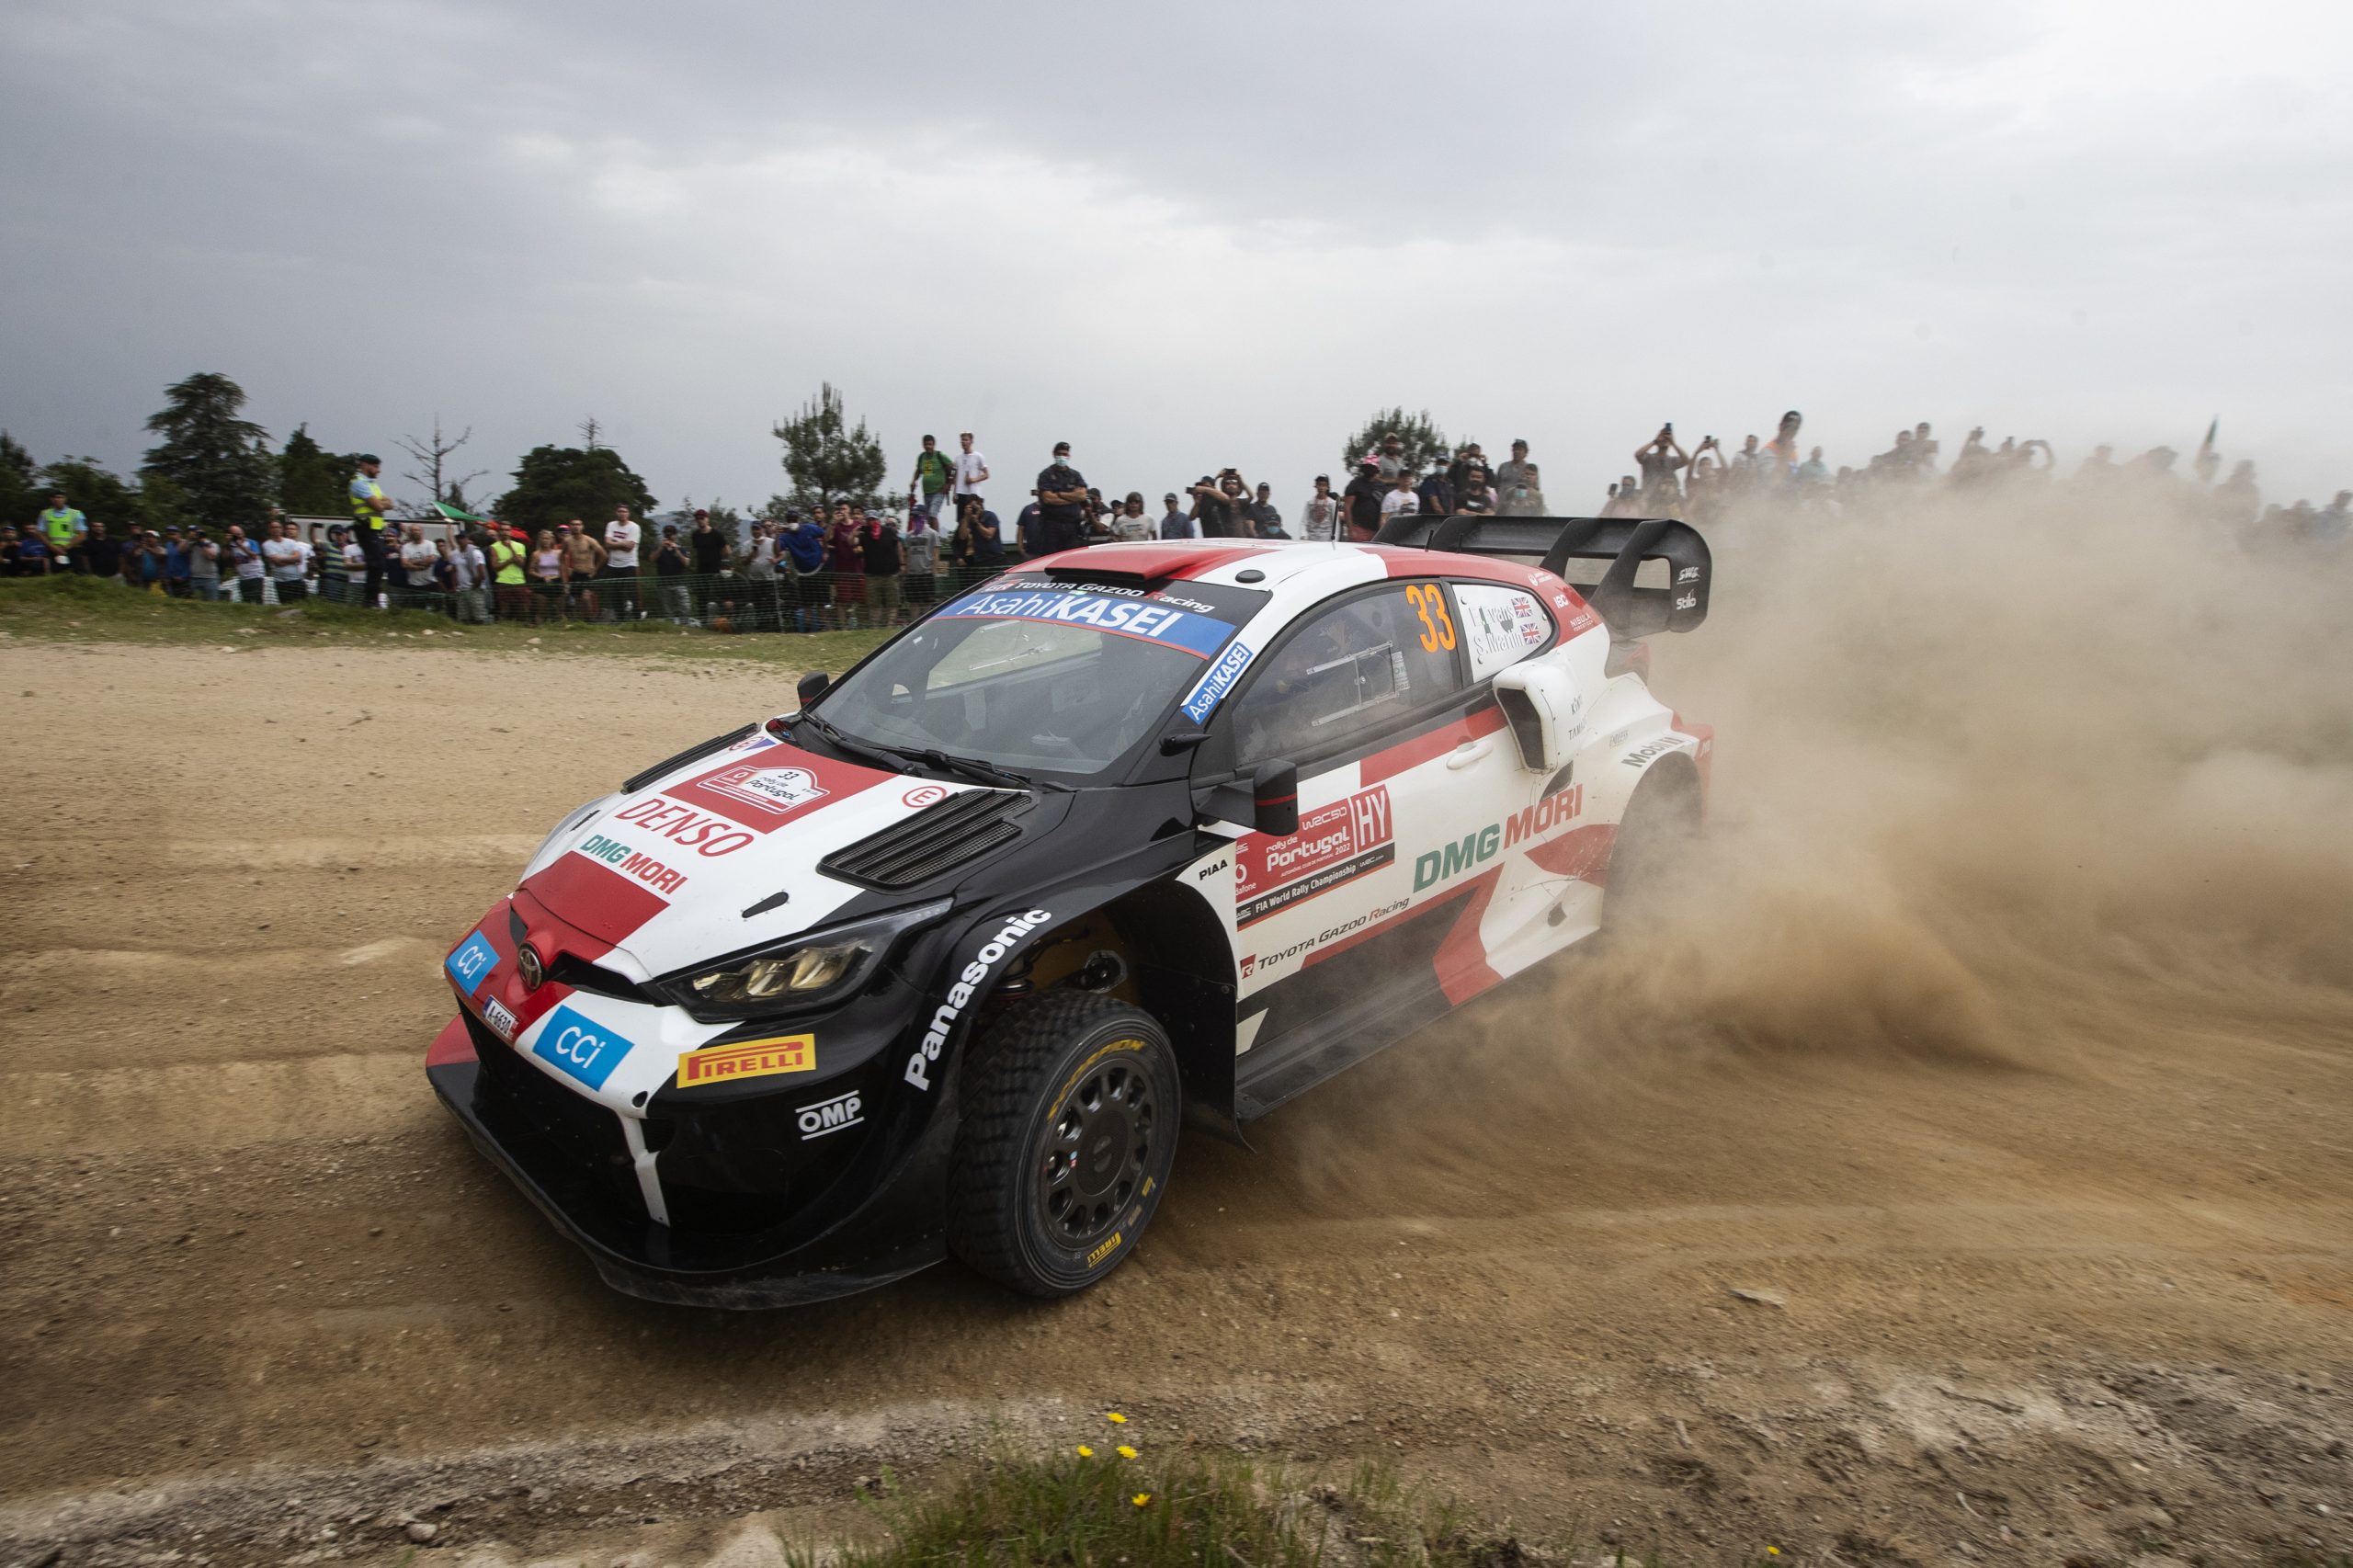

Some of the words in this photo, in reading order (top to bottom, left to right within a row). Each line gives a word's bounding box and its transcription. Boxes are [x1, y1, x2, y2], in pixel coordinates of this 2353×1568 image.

[1016, 582, 1075, 591] TOYOTA
[1080, 583, 1145, 597] GAZOO
[1145, 590, 1215, 613] Racing
[1405, 584, 1456, 653] 33
[778, 771, 800, 780] 33
[614, 798, 755, 858] DENSO
[1356, 793, 1386, 846] HY
[1413, 824, 1501, 893] DMG
[1503, 783, 1584, 850] MORI
[580, 835, 631, 864] DMG
[620, 852, 688, 895] MORI
[1199, 858, 1228, 881] PIAA
[1266, 840, 1286, 853] rally
[1267, 826, 1350, 872] Portugal
[1256, 902, 1268, 914] FIA
[1269, 891, 1290, 907] World
[1291, 883, 1310, 900] Rally
[1311, 864, 1357, 890] Championship
[1258, 937, 1315, 970] TOYOTA
[1319, 915, 1367, 943] GAZOO
[1369, 897, 1410, 922] Racing
[904, 909, 1052, 1092] Panasonic
[687, 1040, 804, 1081] PIRELLI
[798, 1096, 862, 1133] OMP
